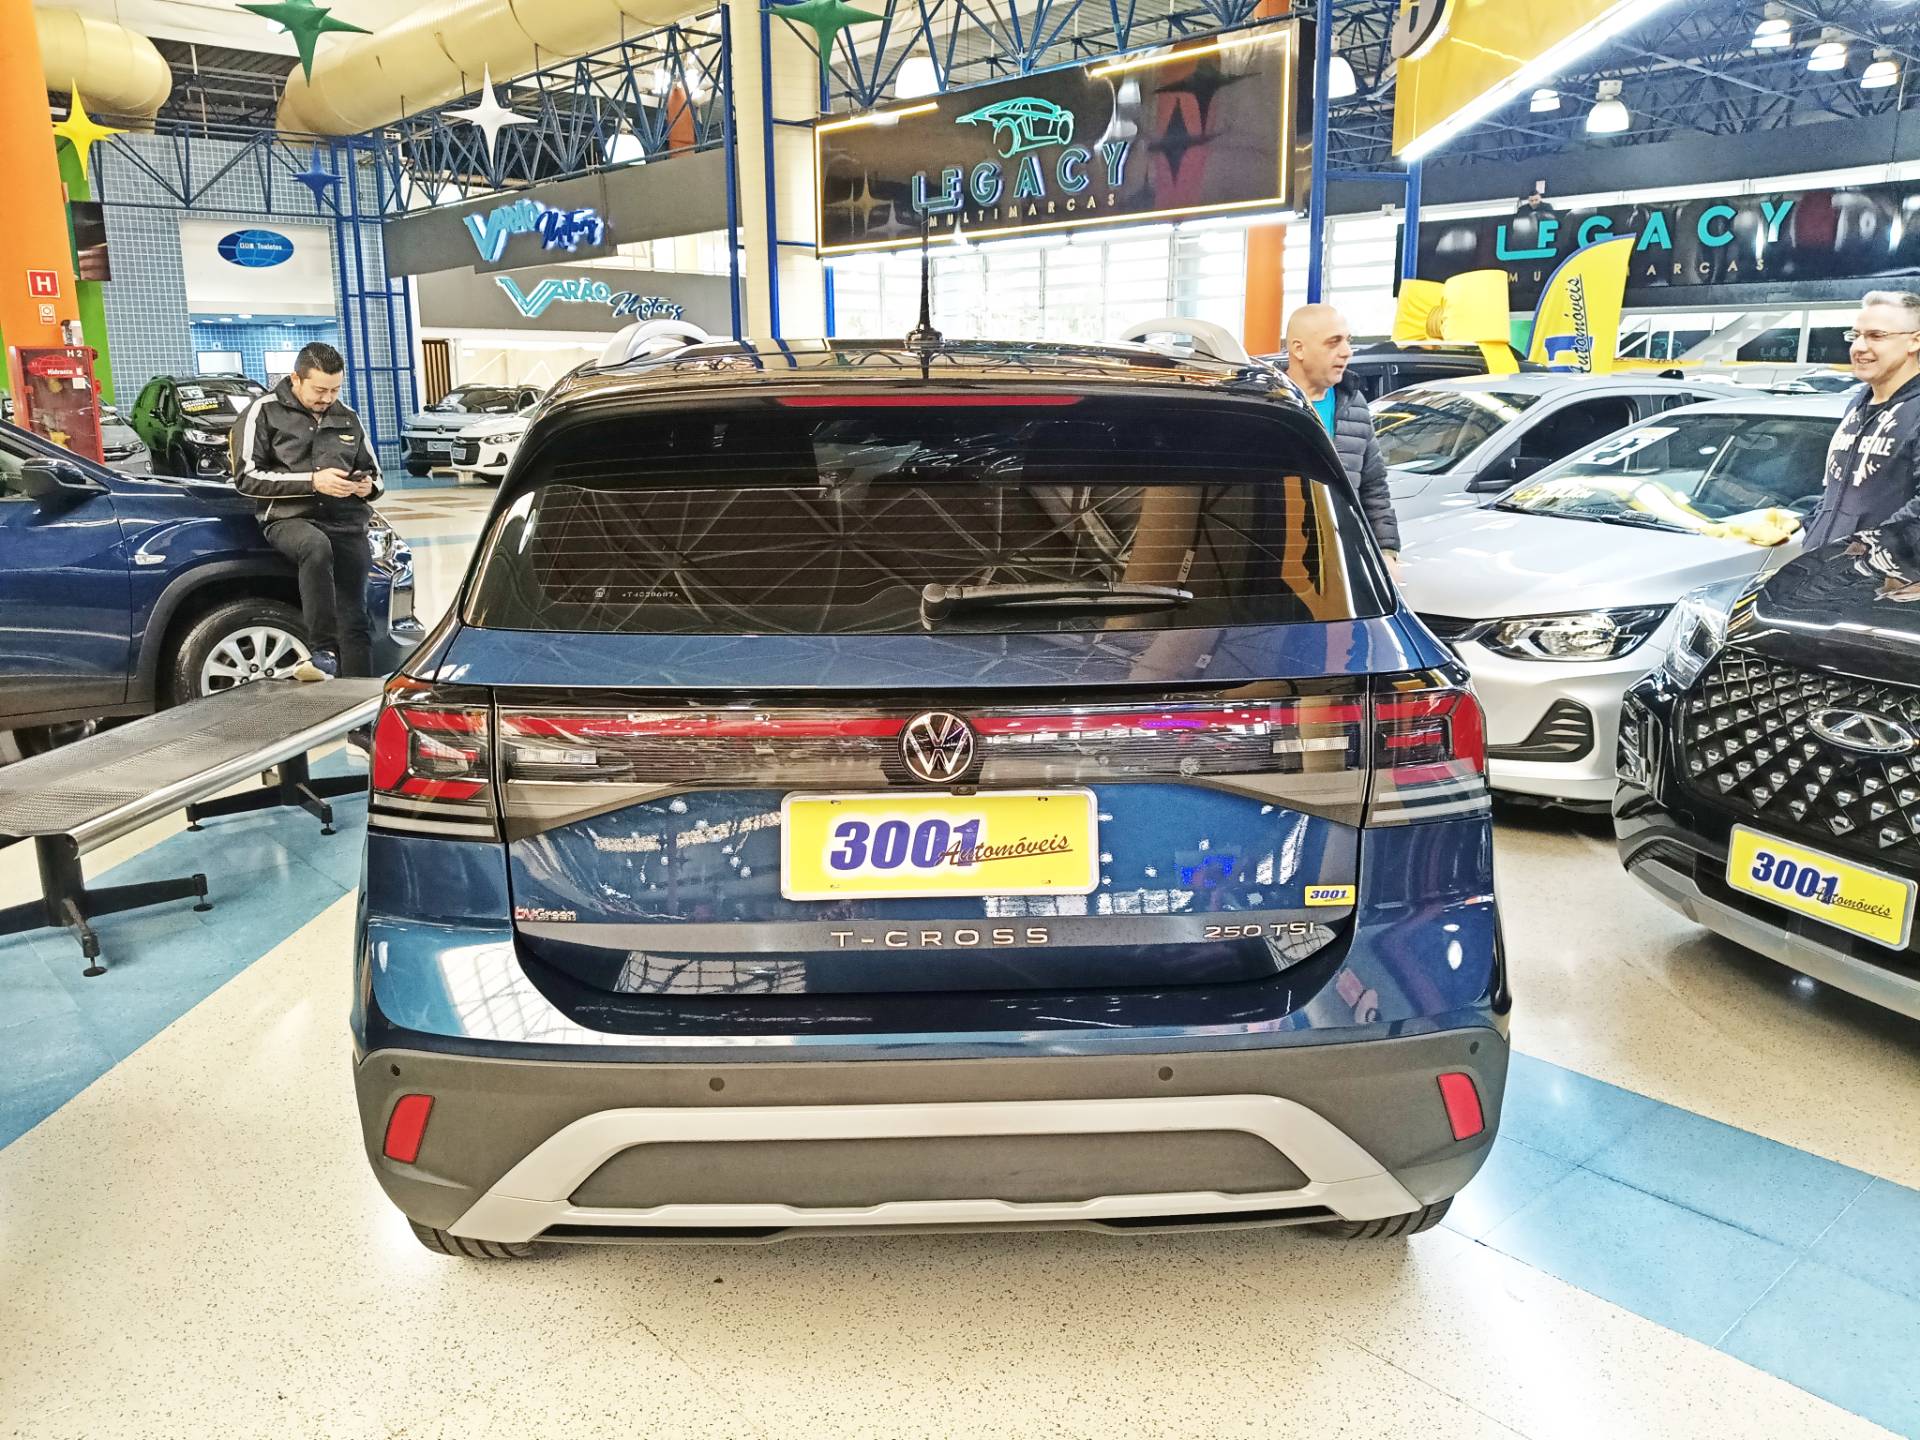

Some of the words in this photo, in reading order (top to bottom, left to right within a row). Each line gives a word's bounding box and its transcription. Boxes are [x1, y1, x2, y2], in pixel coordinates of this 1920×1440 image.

[911, 141, 1128, 214] LEGACY
[929, 193, 1115, 228] MULTIMARCAS
[36, 276, 52, 292] H
[1507, 258, 1766, 283] MUARCAS
[496, 277, 613, 318] VARÃO
[607, 290, 686, 322] Motors
[829, 818, 981, 871] 3001
[935, 833, 1073, 865] Automóveis
[1751, 851, 1839, 905] 3001
[1310, 889, 1348, 900] 3001
[829, 927, 1049, 948] T-CROSS
[1203, 925, 1263, 939] 250
[1270, 921, 1315, 937] TSI
